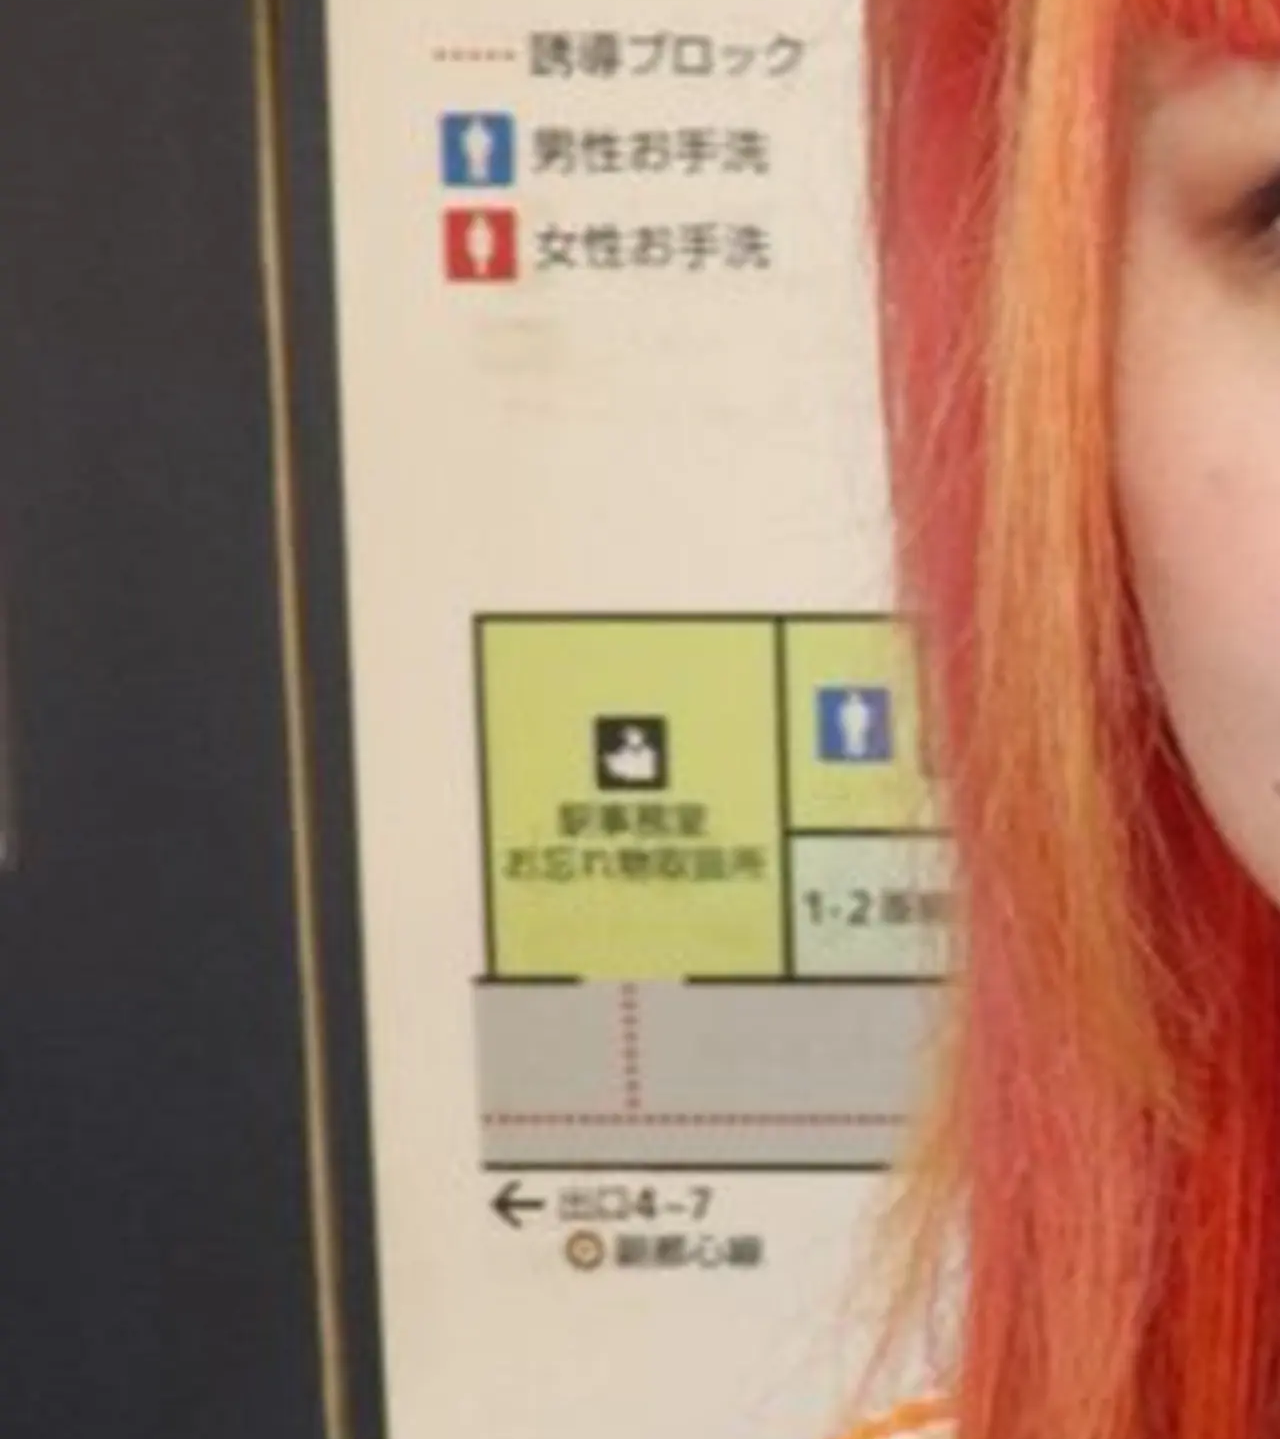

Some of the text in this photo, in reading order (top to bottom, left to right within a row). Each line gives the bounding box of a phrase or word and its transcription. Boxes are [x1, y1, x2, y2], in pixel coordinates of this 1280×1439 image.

[528, 30, 807, 79] 誘導ブロック
[531, 127, 772, 176] 男性お手洗
[533, 222, 773, 271] 女性お手洗
